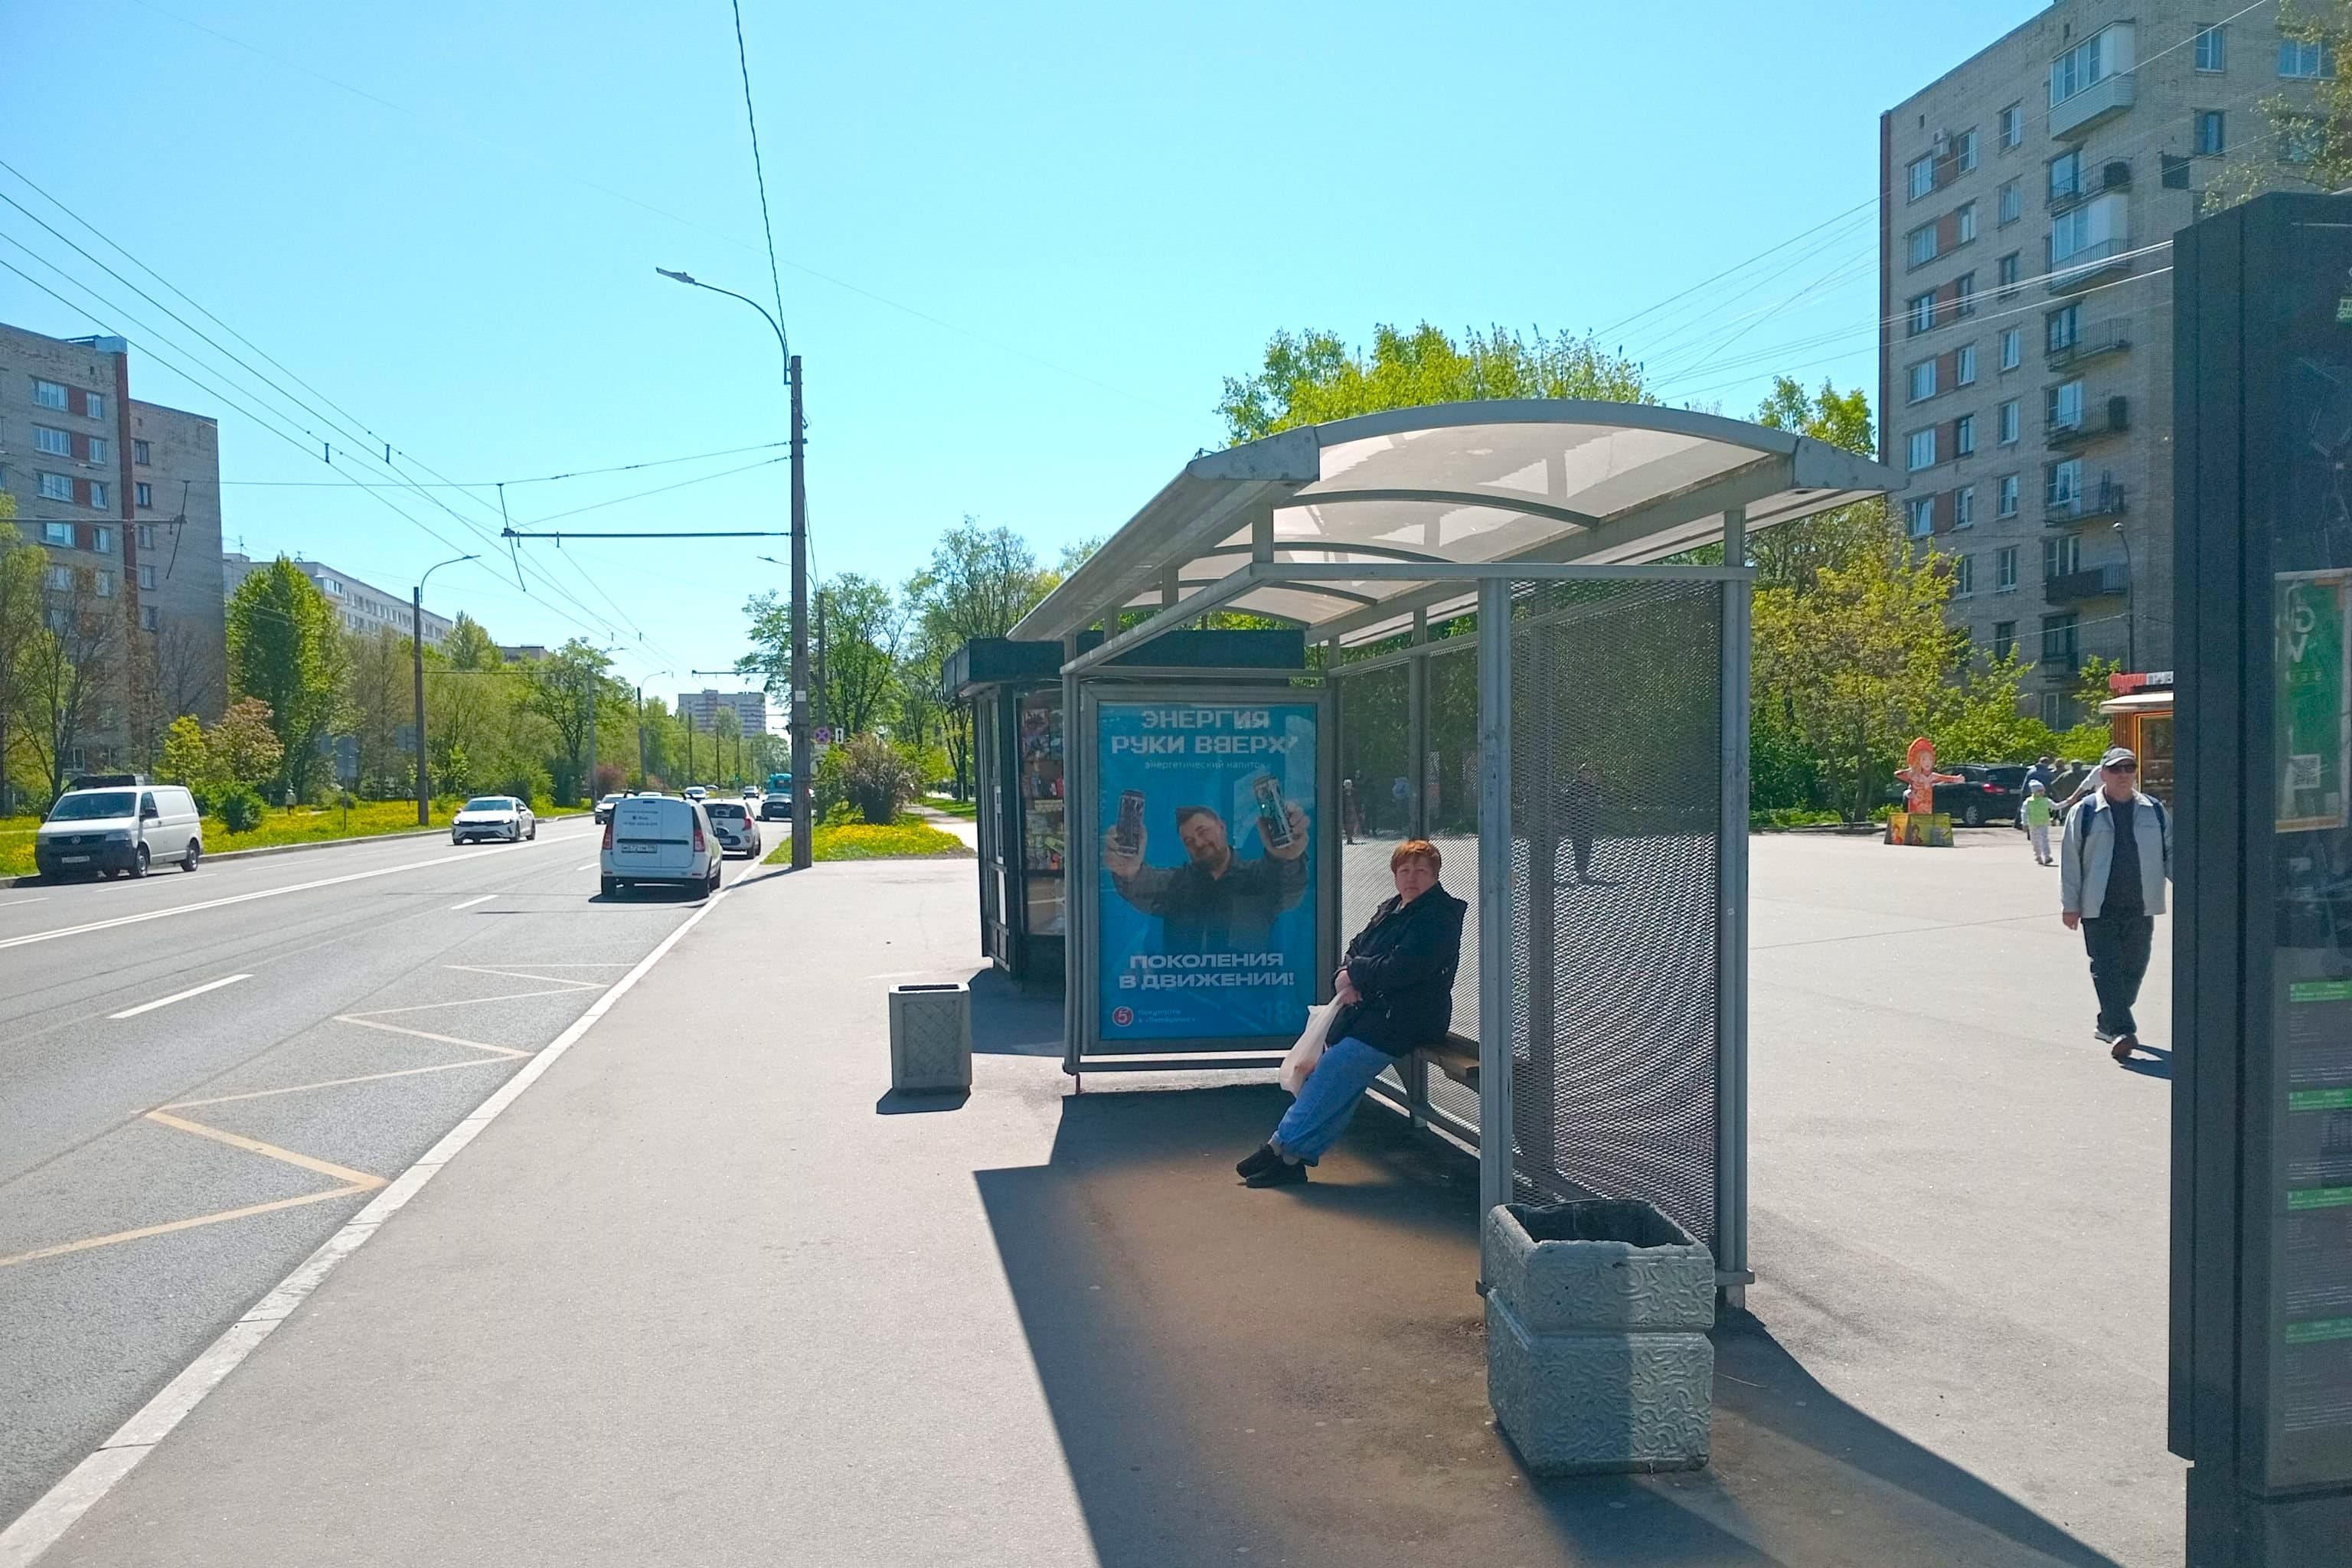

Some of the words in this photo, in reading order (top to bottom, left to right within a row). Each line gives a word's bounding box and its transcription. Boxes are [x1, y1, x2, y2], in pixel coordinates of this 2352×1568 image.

[1141, 710, 1270, 729] ЭНЕРГИЯ
[1111, 735, 1185, 754] РУКИ
[1130, 953, 1284, 969] ПОКОЛЕНИЯ
[1119, 974, 1137, 988] В
[1141, 972, 1295, 991] ДВИЖЕНИИ!
